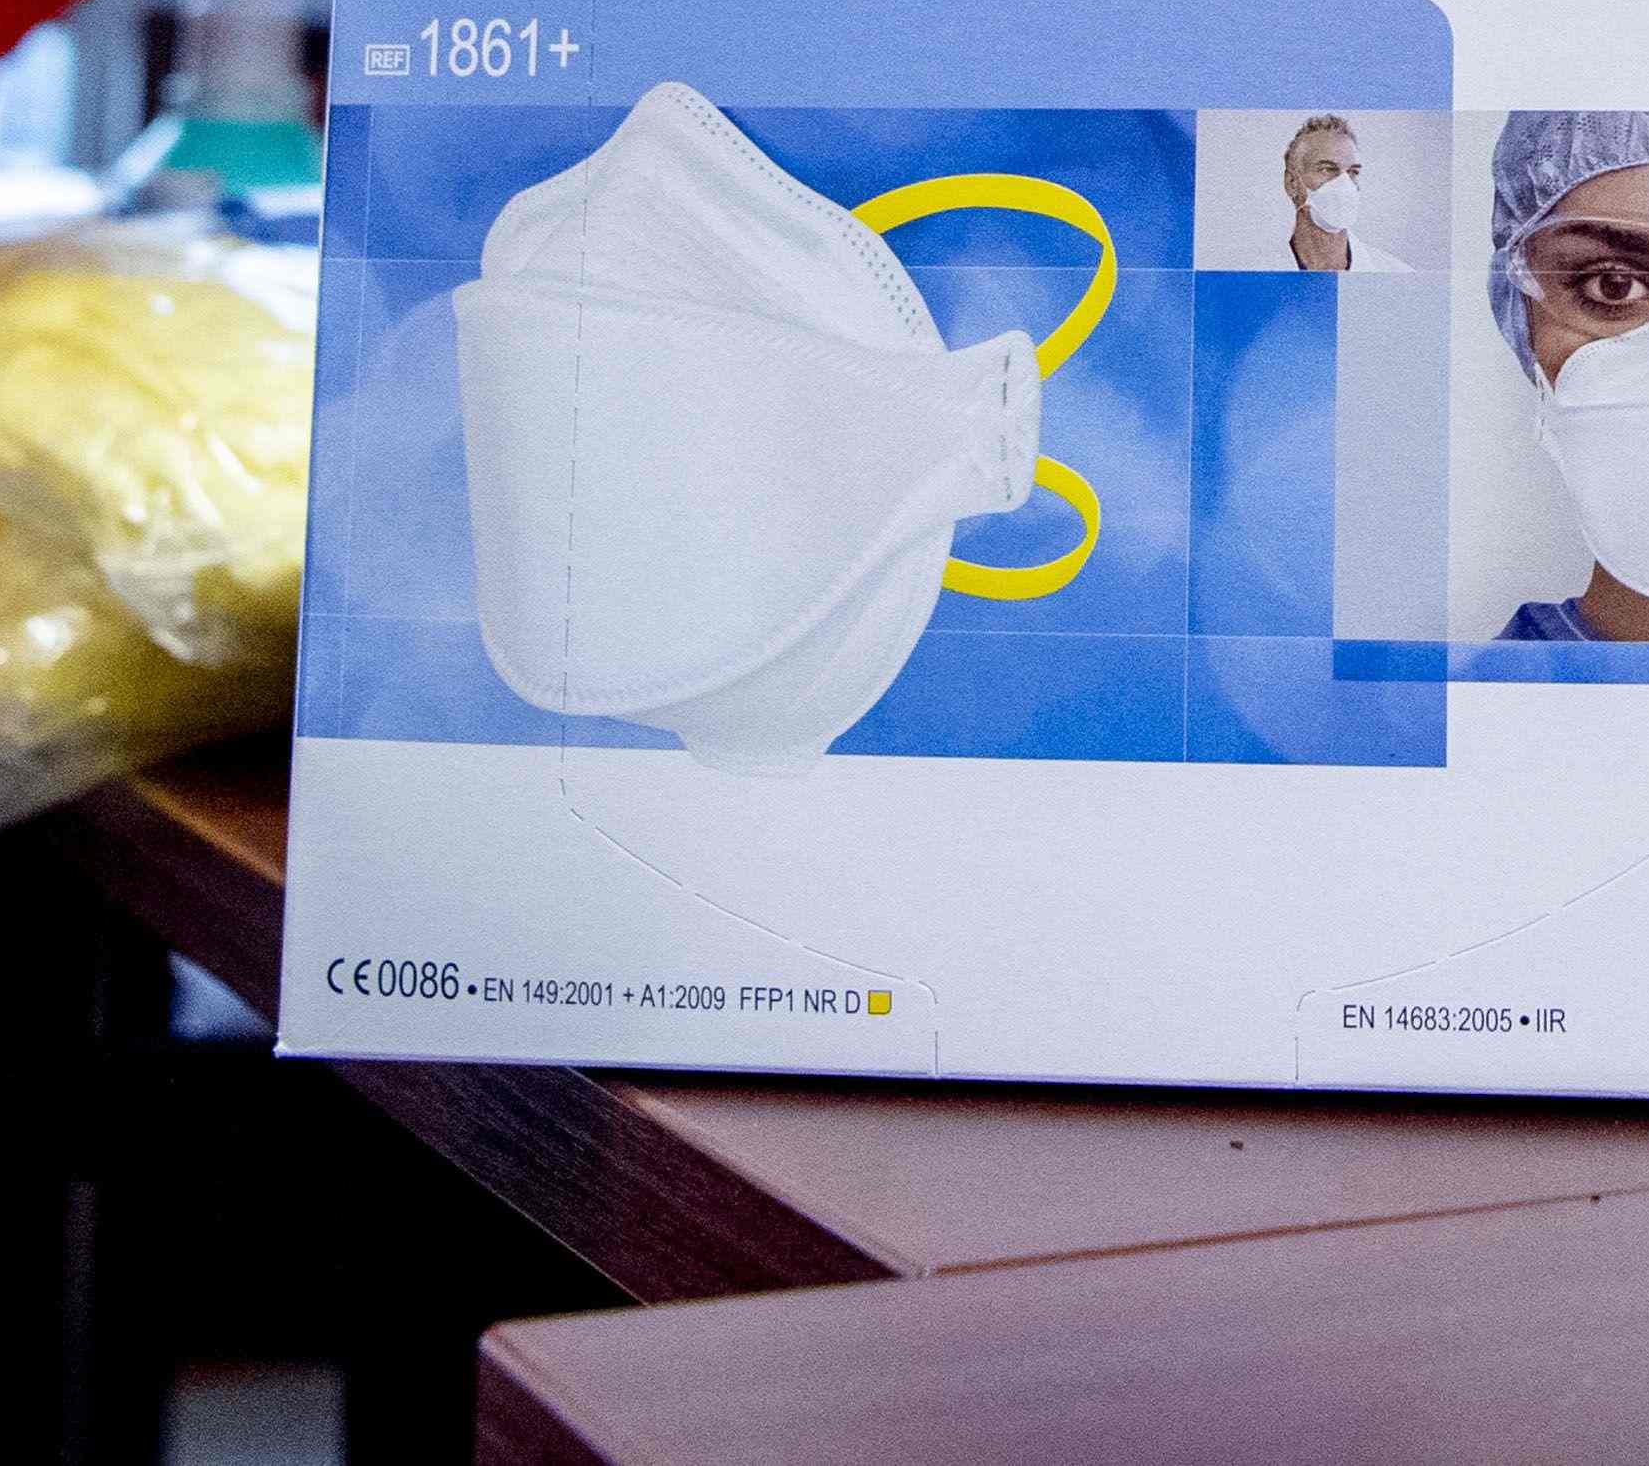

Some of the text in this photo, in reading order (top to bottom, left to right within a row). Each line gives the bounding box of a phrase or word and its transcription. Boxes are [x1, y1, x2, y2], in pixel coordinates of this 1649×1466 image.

[370, 17, 580, 78] REF 1861+
[483, 977, 514, 1002] EN
[522, 979, 613, 1007] 149:2001
[639, 983, 726, 1011] A1:2009
[739, 986, 794, 1012] FFP1
[804, 989, 837, 1013] NR
[844, 989, 861, 1015] D
[1343, 1004, 1566, 1033] EN 14683:2005 IIR
